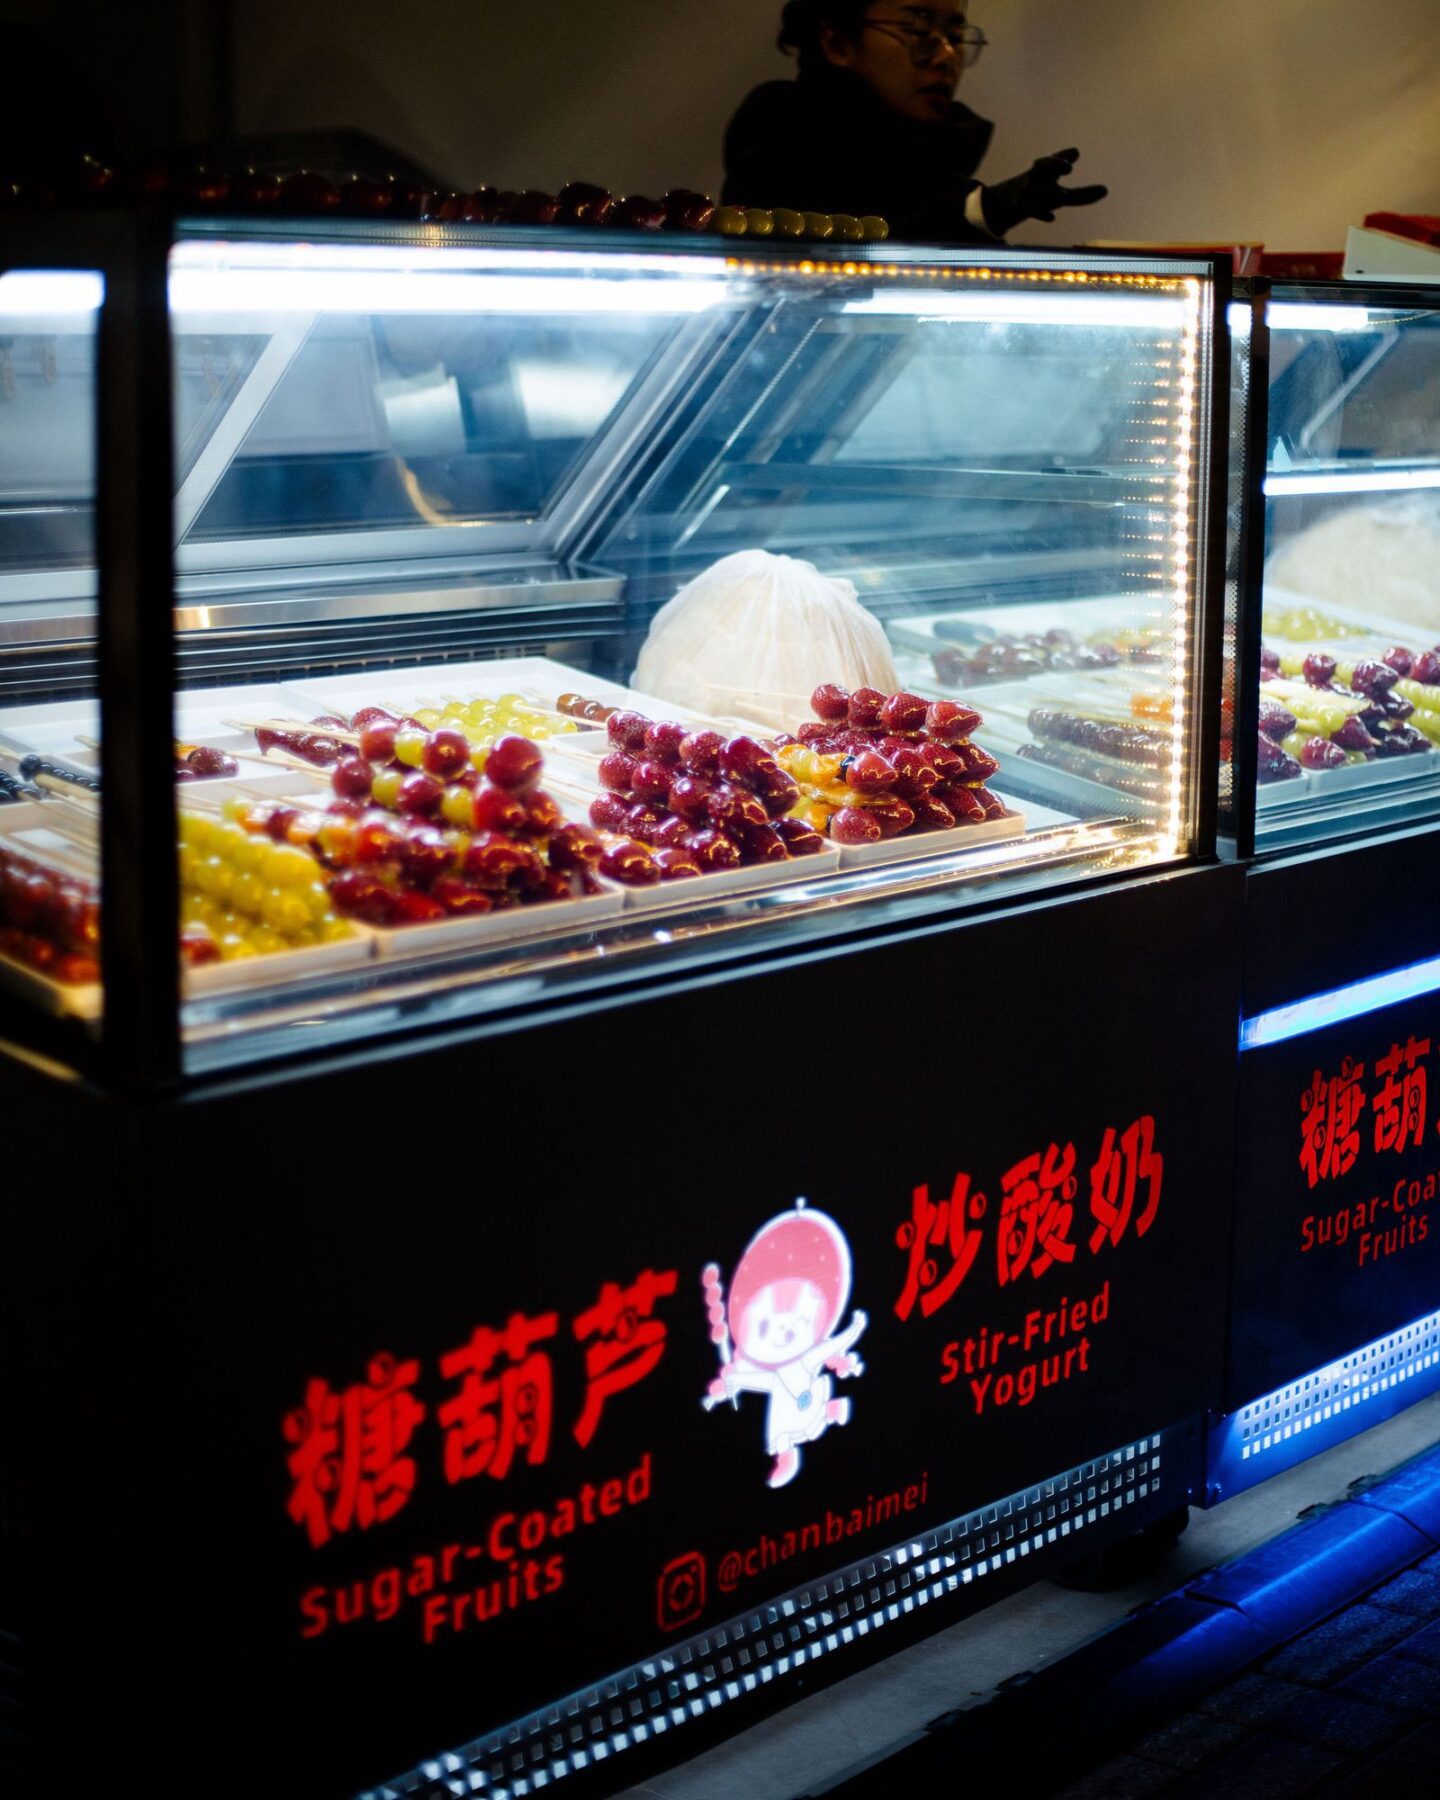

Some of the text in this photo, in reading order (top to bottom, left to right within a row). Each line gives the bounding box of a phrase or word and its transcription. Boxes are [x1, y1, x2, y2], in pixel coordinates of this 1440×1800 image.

[1298, 1035, 1440, 1190] 糖葫
[893, 1115, 1164, 1322] 炒酸奶
[1301, 1171, 1440, 1252] Sugar-Coa
[1357, 1213, 1430, 1268] Fruits
[939, 1280, 1111, 1385] Stir-Fried
[969, 1336, 1091, 1416] Yogurt
[282, 1269, 679, 1549] 糖葫芦
[301, 1452, 652, 1639] Sugar-Coated
[717, 1471, 930, 1594] @chanbaimei
[422, 1553, 565, 1645] Fruits
